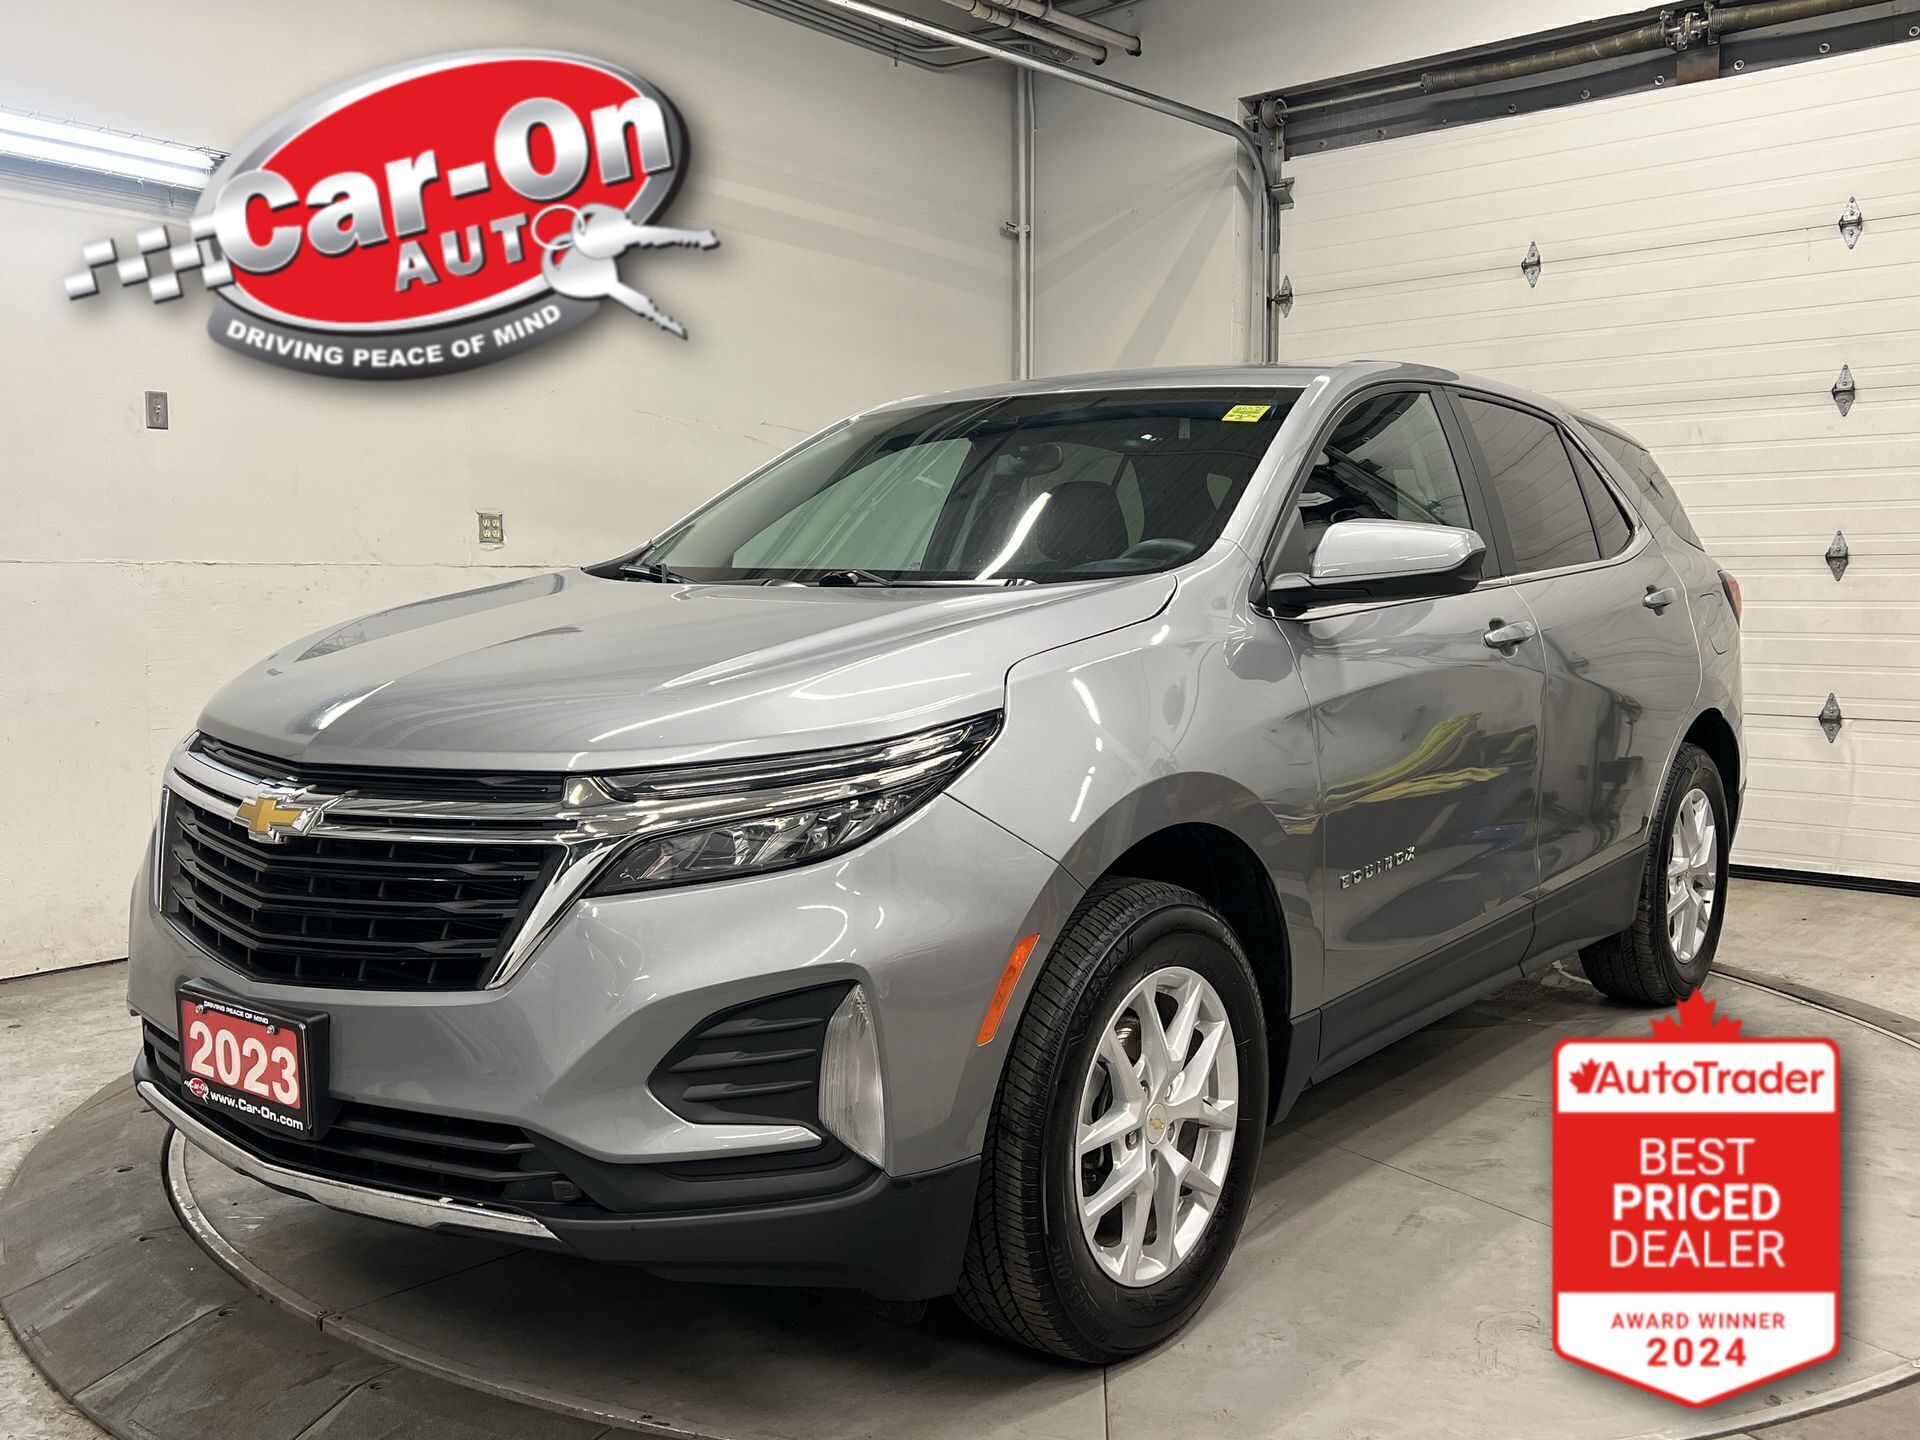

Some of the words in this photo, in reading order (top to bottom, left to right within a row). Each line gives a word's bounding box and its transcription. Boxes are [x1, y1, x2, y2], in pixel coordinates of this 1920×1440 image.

[1339, 846, 1416, 890] EQUINOX
[203, 1000, 226, 1012] DRIVING
[225, 1006, 245, 1018] PEACE
[244, 1012, 253, 1020] OF
[253, 1014, 269, 1025] MIND
[189, 1021, 298, 1105] 2023
[209, 1091, 304, 1131] www.Car-On.com
